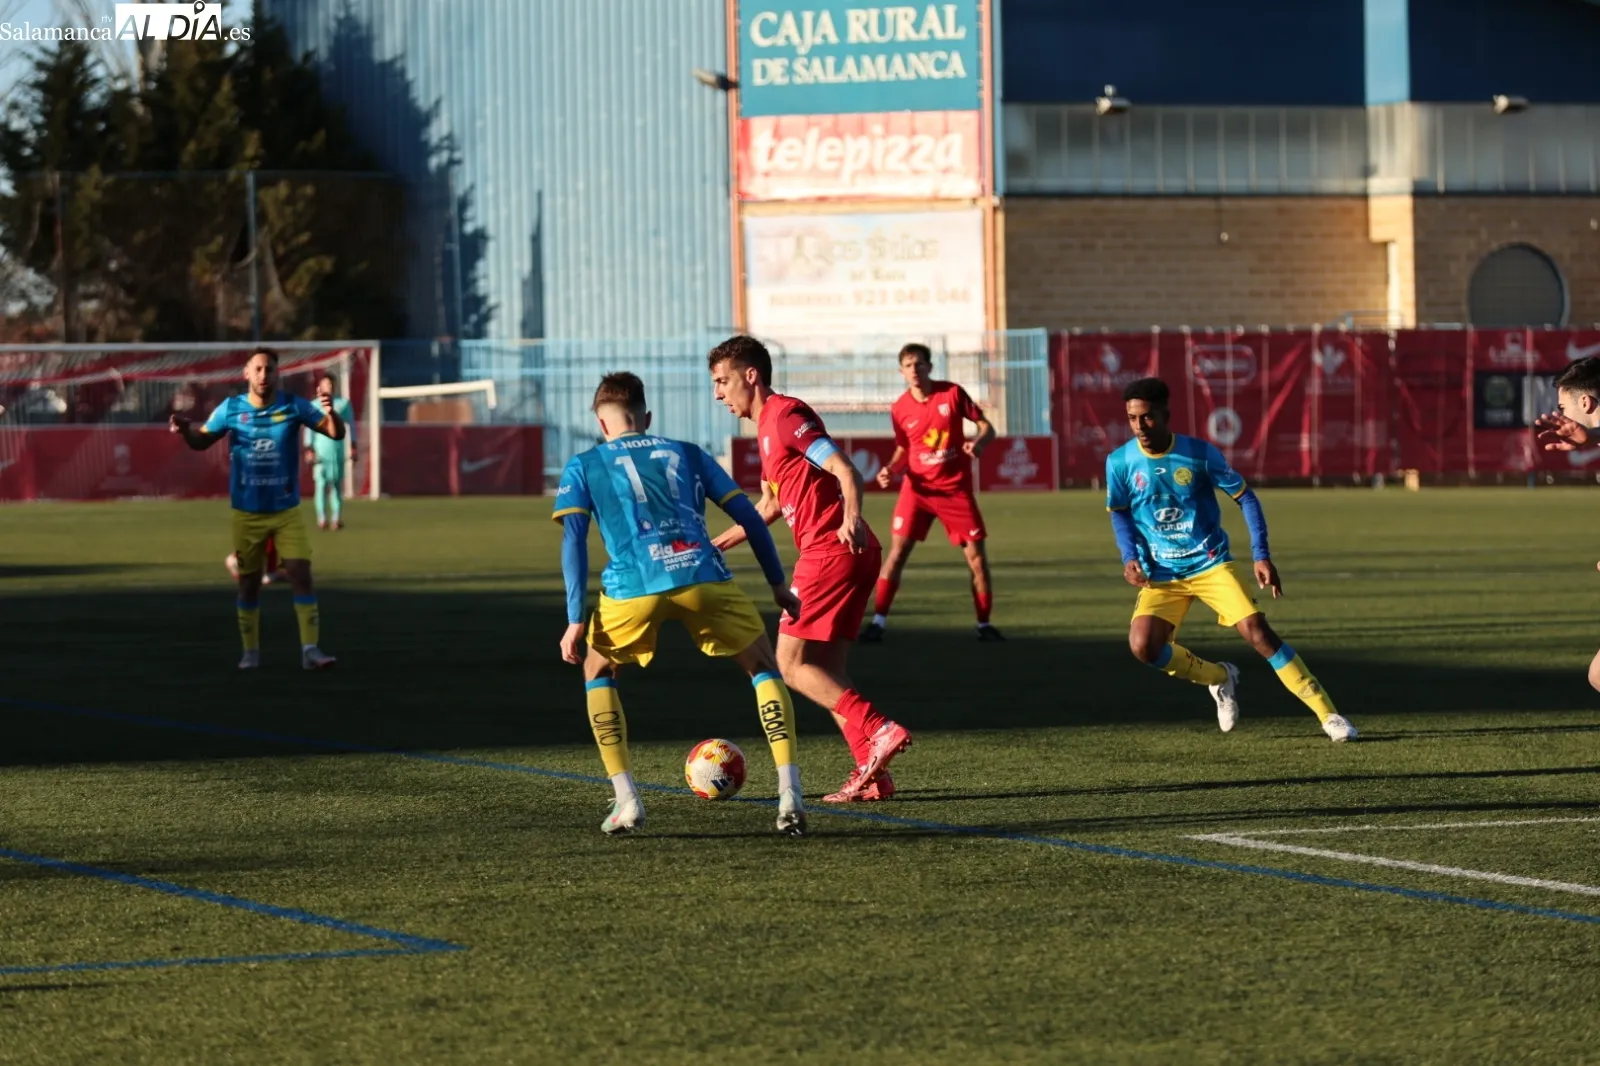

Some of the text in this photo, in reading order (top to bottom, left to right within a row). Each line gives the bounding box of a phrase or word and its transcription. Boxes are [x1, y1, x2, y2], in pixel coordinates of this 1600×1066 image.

[750, 4, 967, 55] CAJA RURAL
[752, 51, 967, 86] DE SALAMANCA
[753, 123, 964, 183] telepizza
[614, 449, 681, 504] 17
[664, 563, 680, 572] CITY
[760, 699, 789, 743] DIOCES
